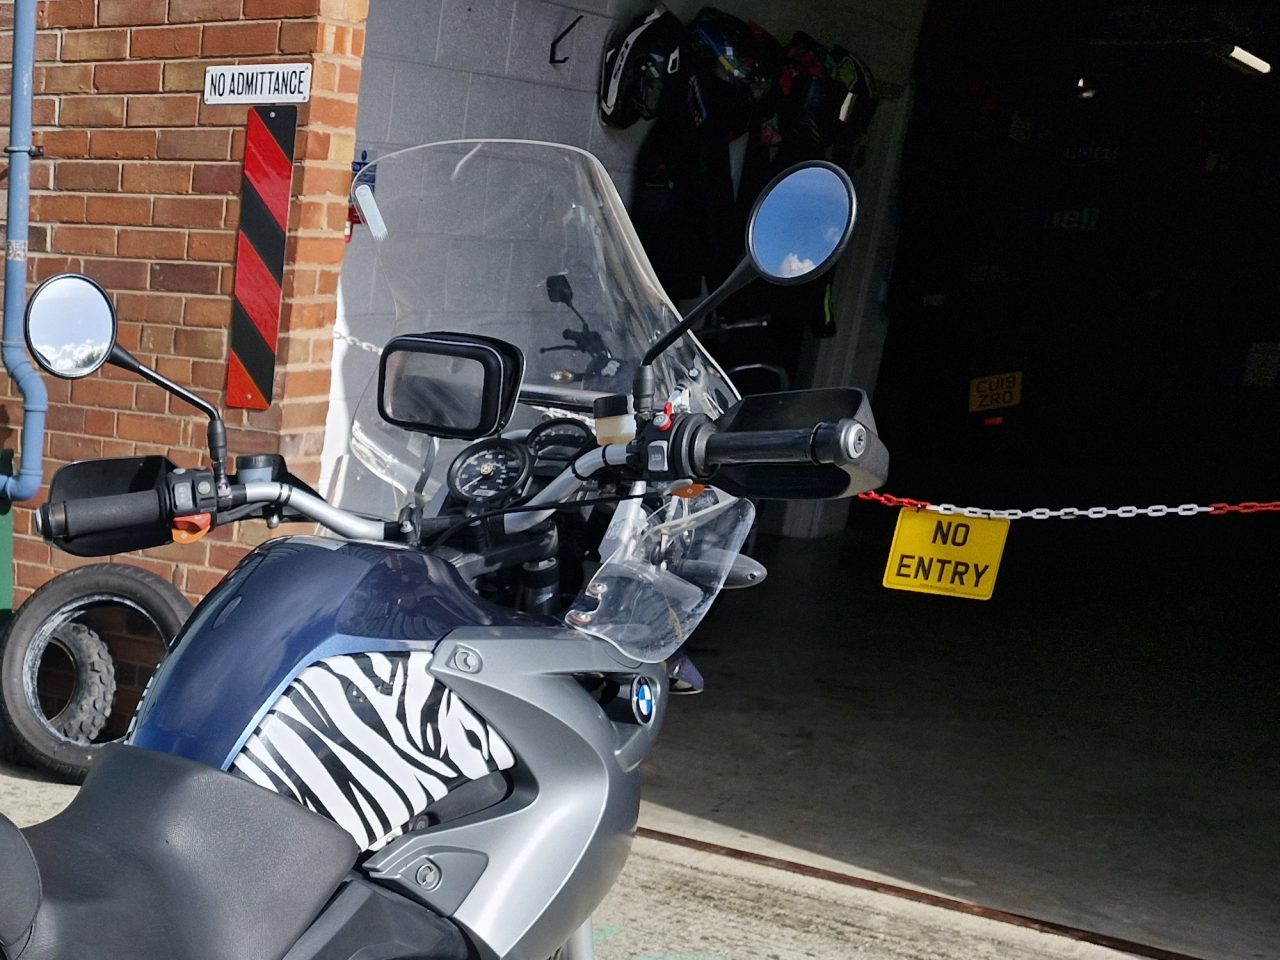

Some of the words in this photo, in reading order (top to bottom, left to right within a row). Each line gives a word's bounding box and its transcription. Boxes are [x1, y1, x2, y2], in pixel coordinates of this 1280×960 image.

[209, 73, 226, 97] NO
[228, 70, 305, 96] ADMITTANCE
[931, 519, 971, 547] NO
[895, 553, 990, 588] ENTRY
